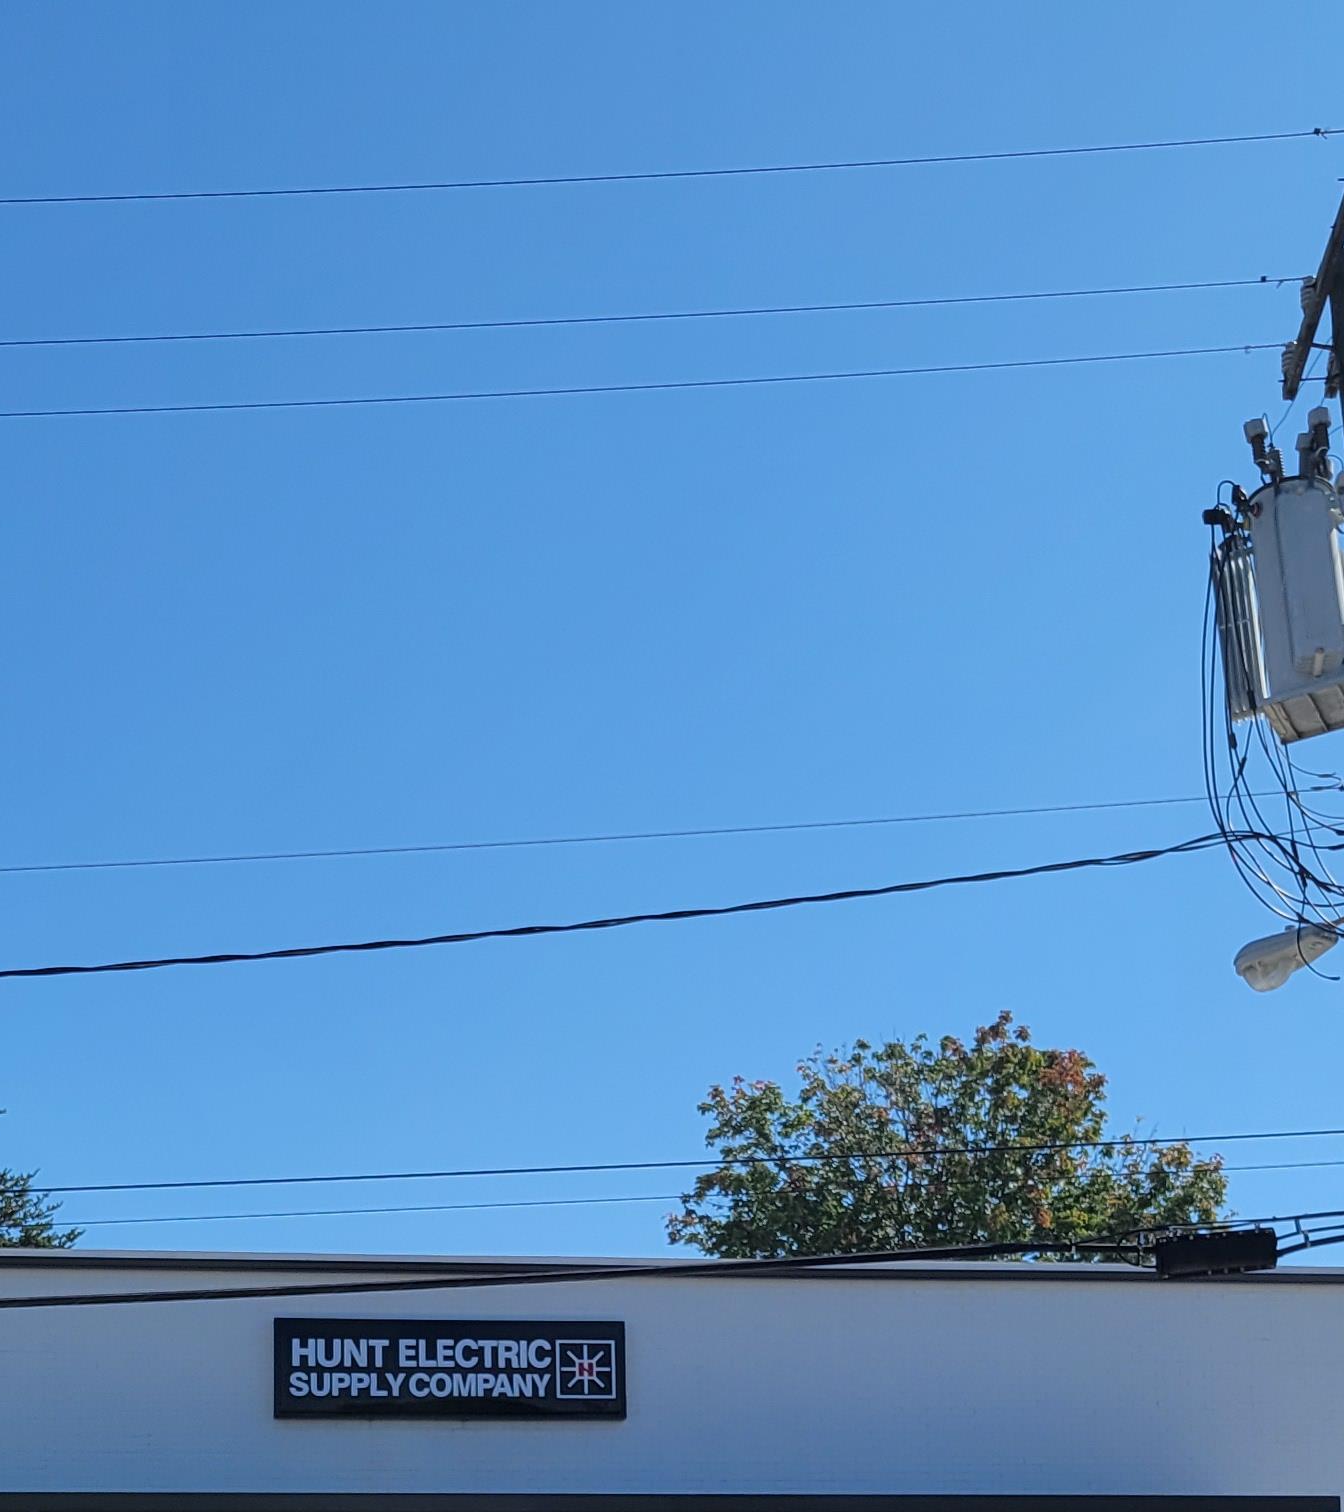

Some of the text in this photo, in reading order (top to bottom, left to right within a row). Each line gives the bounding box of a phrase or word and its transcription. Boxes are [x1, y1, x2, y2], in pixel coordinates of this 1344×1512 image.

[291, 1338, 552, 1369] HUNT ELECTRIC
[289, 1372, 551, 1398] SUPPLY COMPANY
